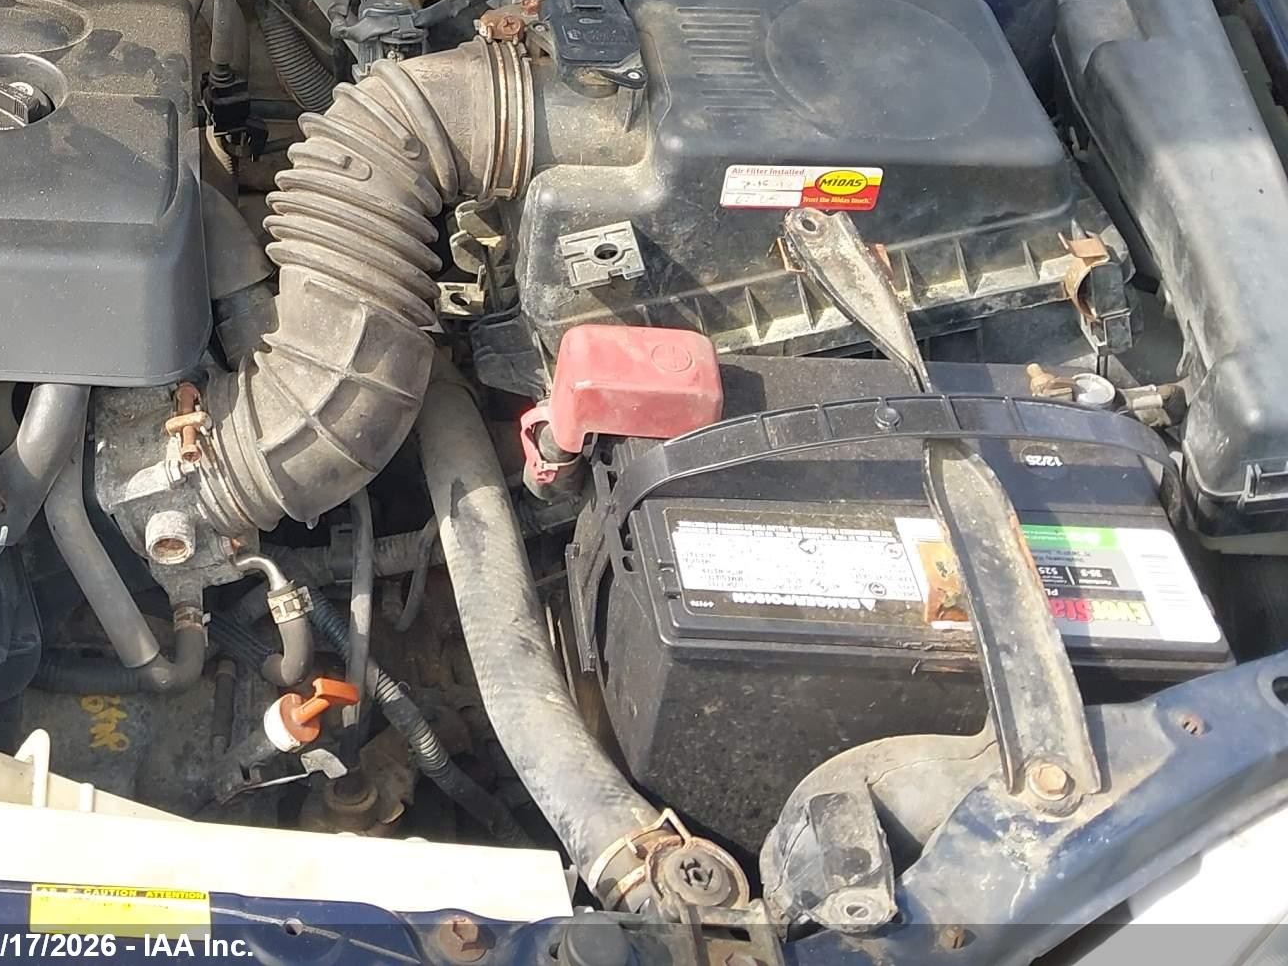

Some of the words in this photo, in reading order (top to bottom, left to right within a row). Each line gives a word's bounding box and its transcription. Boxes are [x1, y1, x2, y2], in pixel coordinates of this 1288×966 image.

[731, 167, 745, 176] Air
[746, 167, 768, 176] Filter
[768, 168, 805, 177] Installed
[1025, 455, 1063, 468] 12/25
[83, 888, 138, 898] CAUTION
[144, 890, 207, 900] ATTENTION
